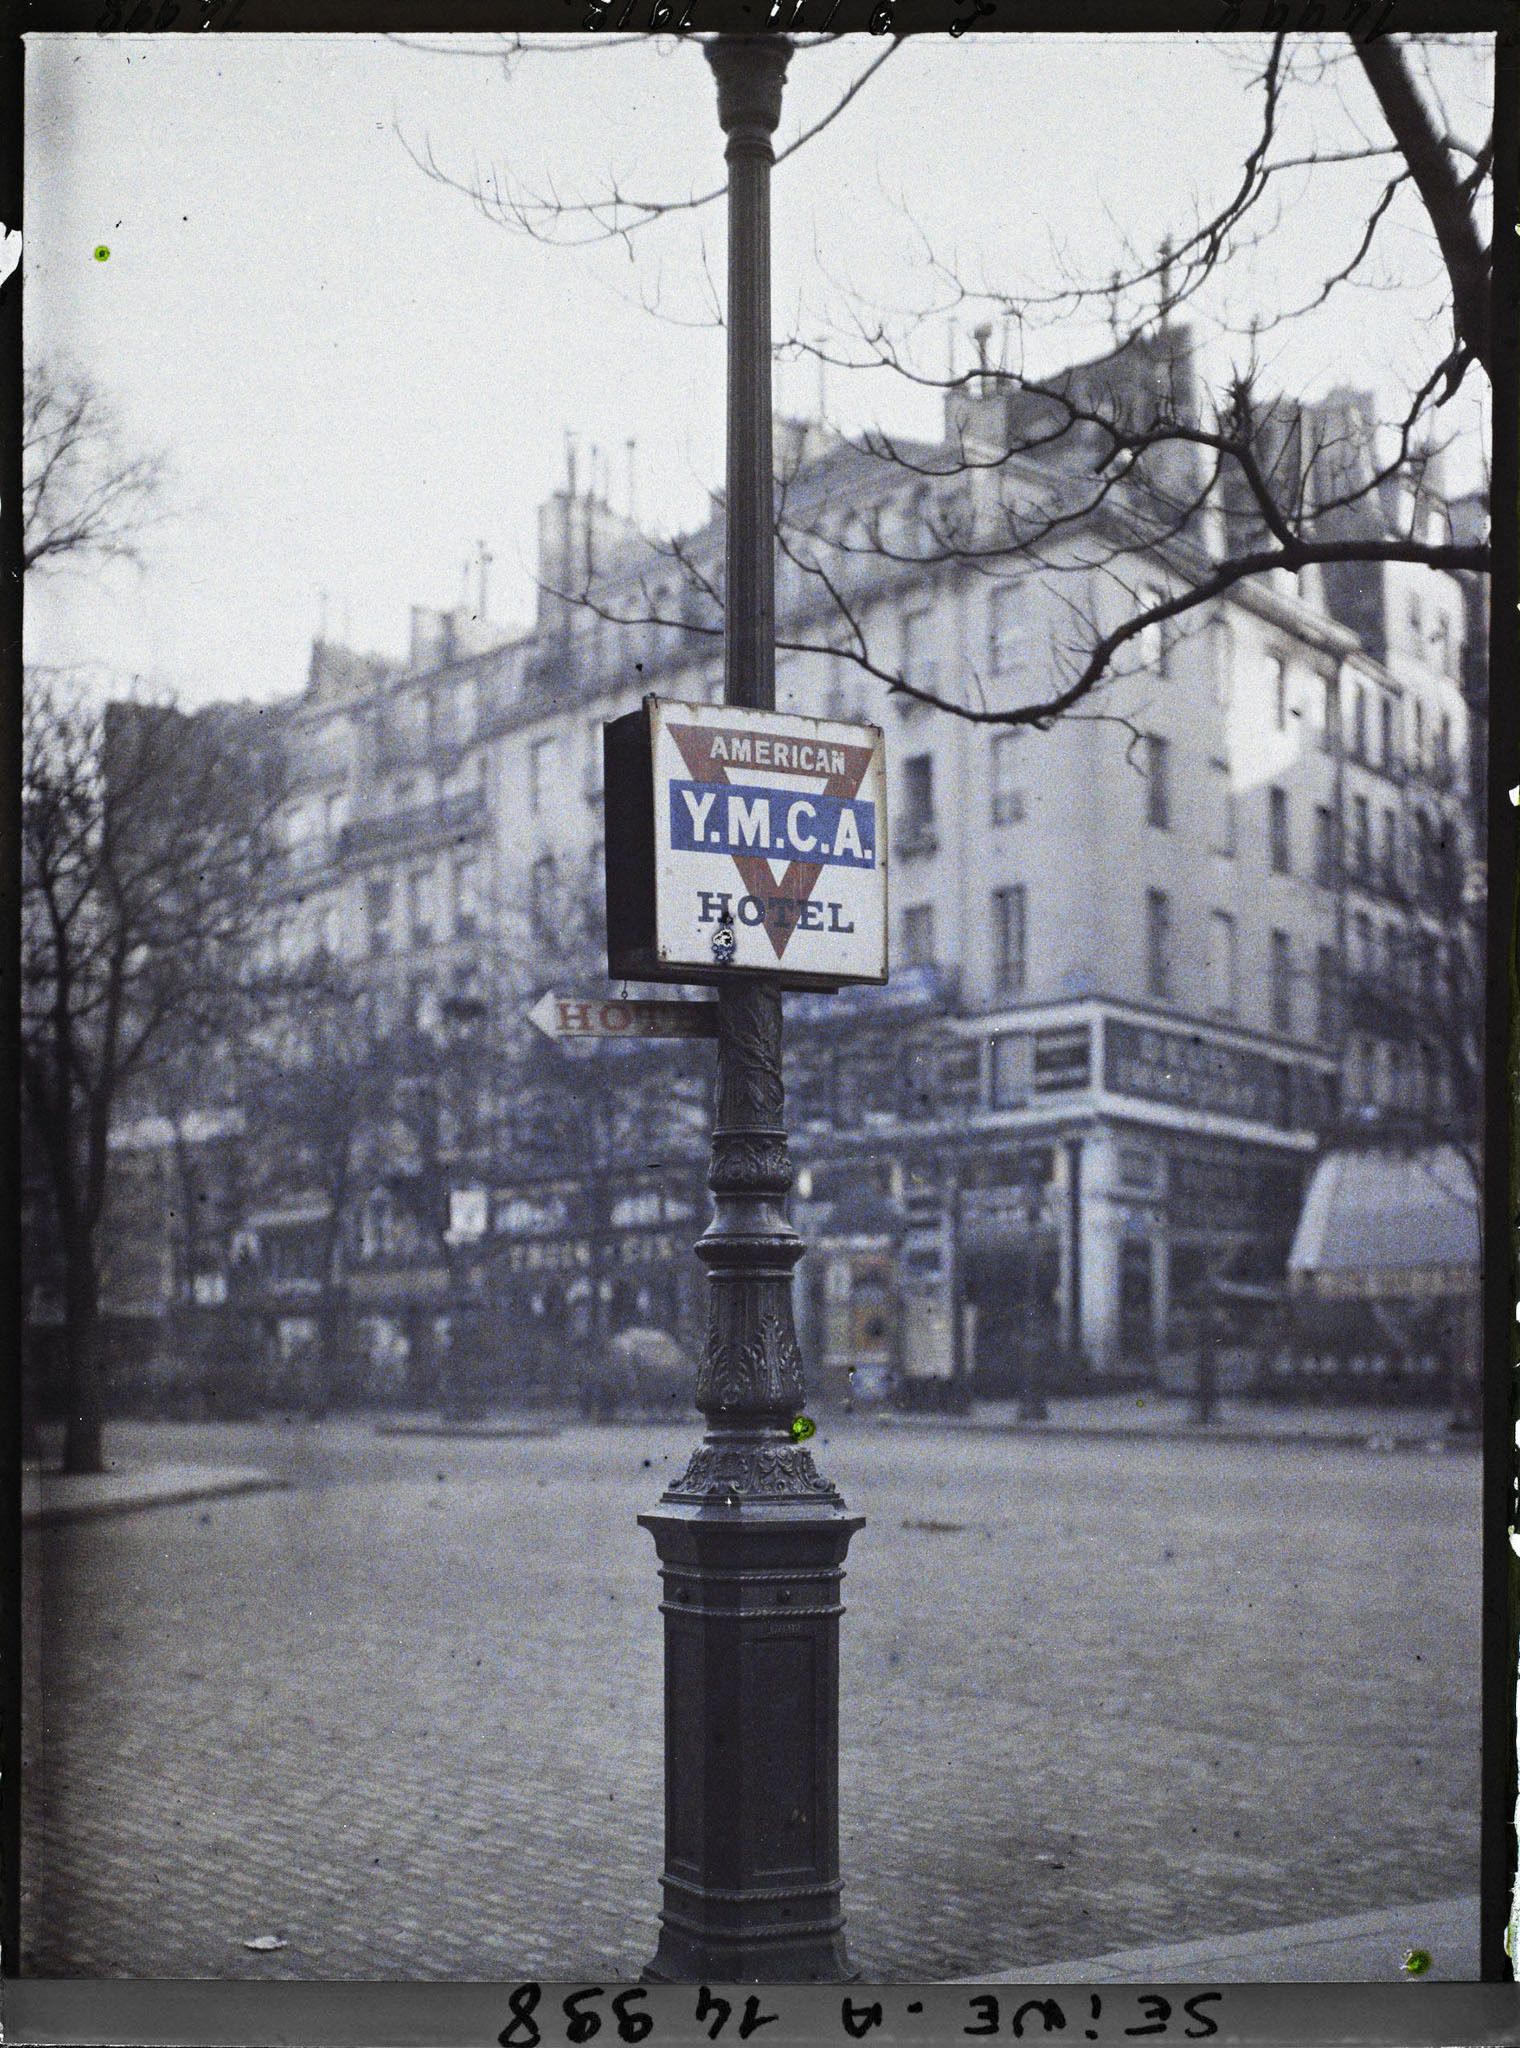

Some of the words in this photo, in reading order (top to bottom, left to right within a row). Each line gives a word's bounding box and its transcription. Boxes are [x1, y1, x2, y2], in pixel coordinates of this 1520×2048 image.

[709, 735, 846, 775] AMERICAN
[680, 790, 874, 860] Y.M.C.A.
[696, 891, 855, 934] HOTEL
